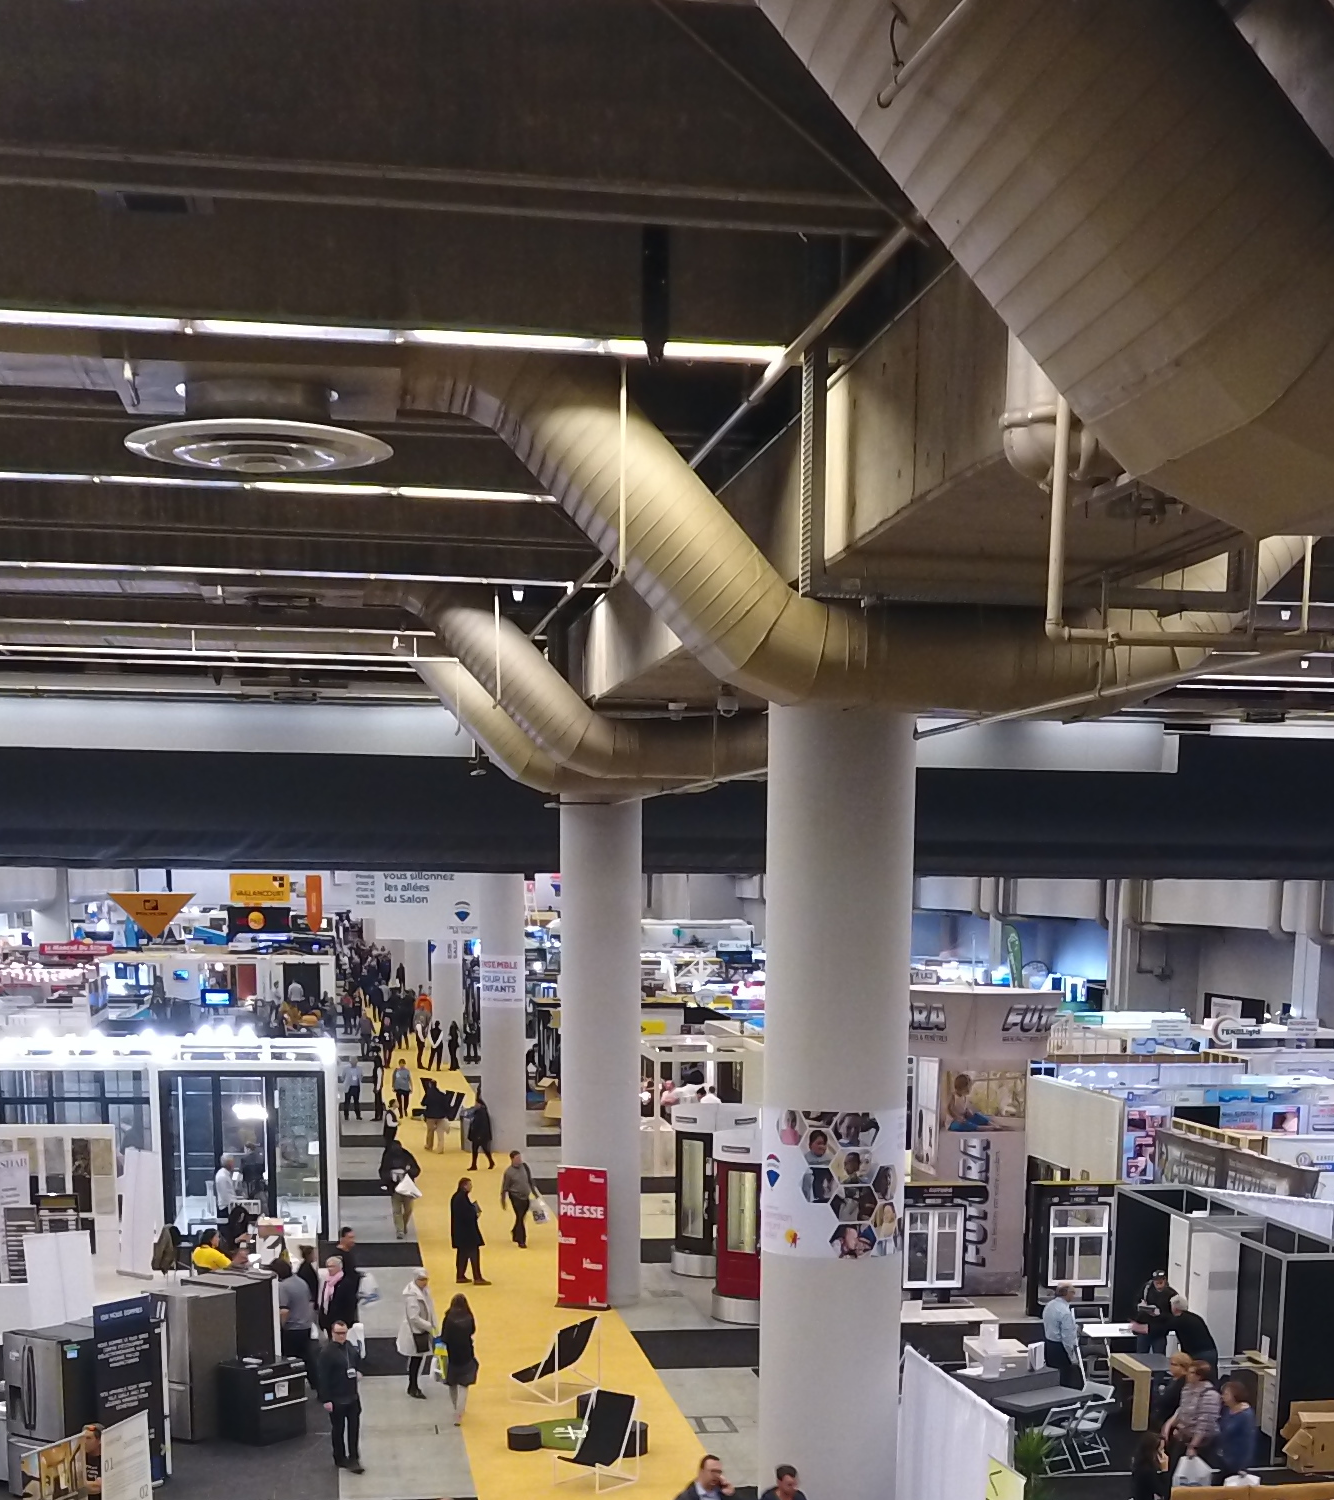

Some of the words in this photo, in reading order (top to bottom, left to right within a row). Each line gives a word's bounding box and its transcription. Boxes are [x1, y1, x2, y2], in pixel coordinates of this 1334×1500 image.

[384, 882, 399, 892] les
[400, 882, 430, 892] allées
[384, 894, 397, 903] du
[399, 894, 429, 904] Salon
[502, 974, 517, 983] LES
[559, 1191, 575, 1204] LA
[559, 1204, 605, 1218] PRESSE
[104, 1458, 113, 1472] 01
[139, 1484, 149, 1499] 02
